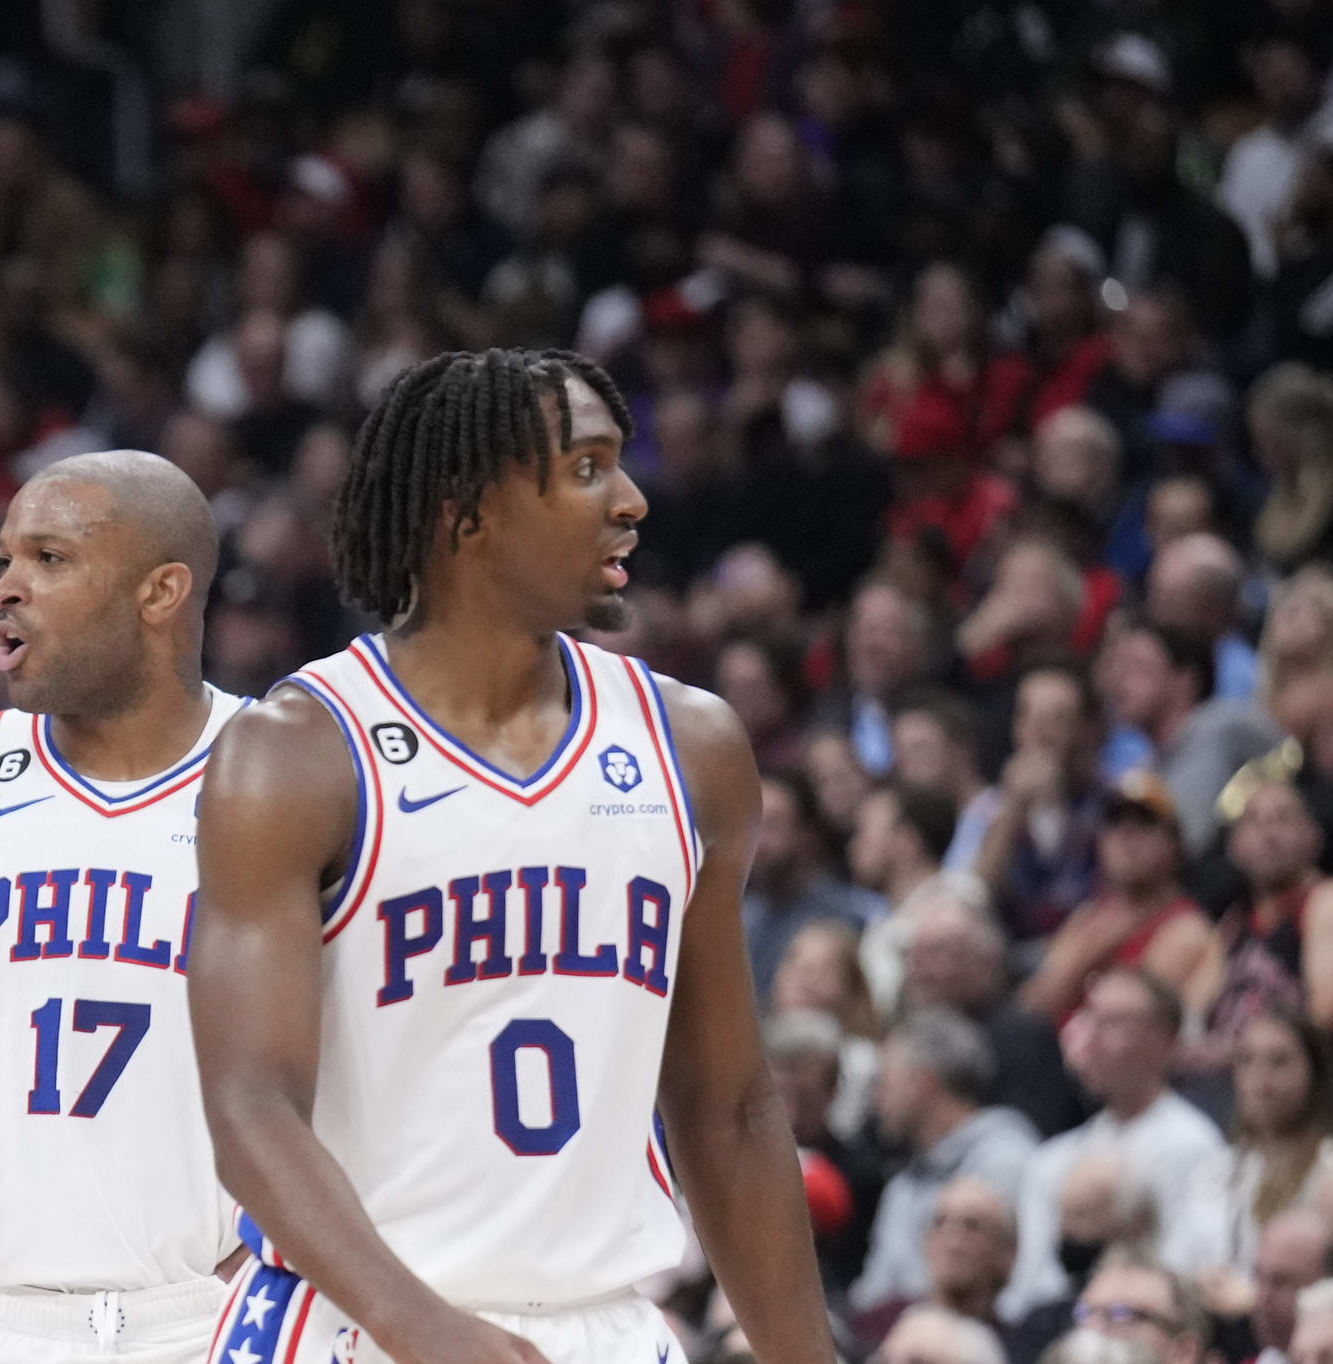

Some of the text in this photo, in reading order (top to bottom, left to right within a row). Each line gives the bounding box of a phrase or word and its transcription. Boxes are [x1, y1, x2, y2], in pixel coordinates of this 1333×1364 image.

[378, 728, 411, 760] 6
[589, 802, 668, 817] crypto.com
[376, 865, 672, 1008] PHILA
[27, 997, 152, 1119] 17
[489, 1018, 581, 1157] 0
